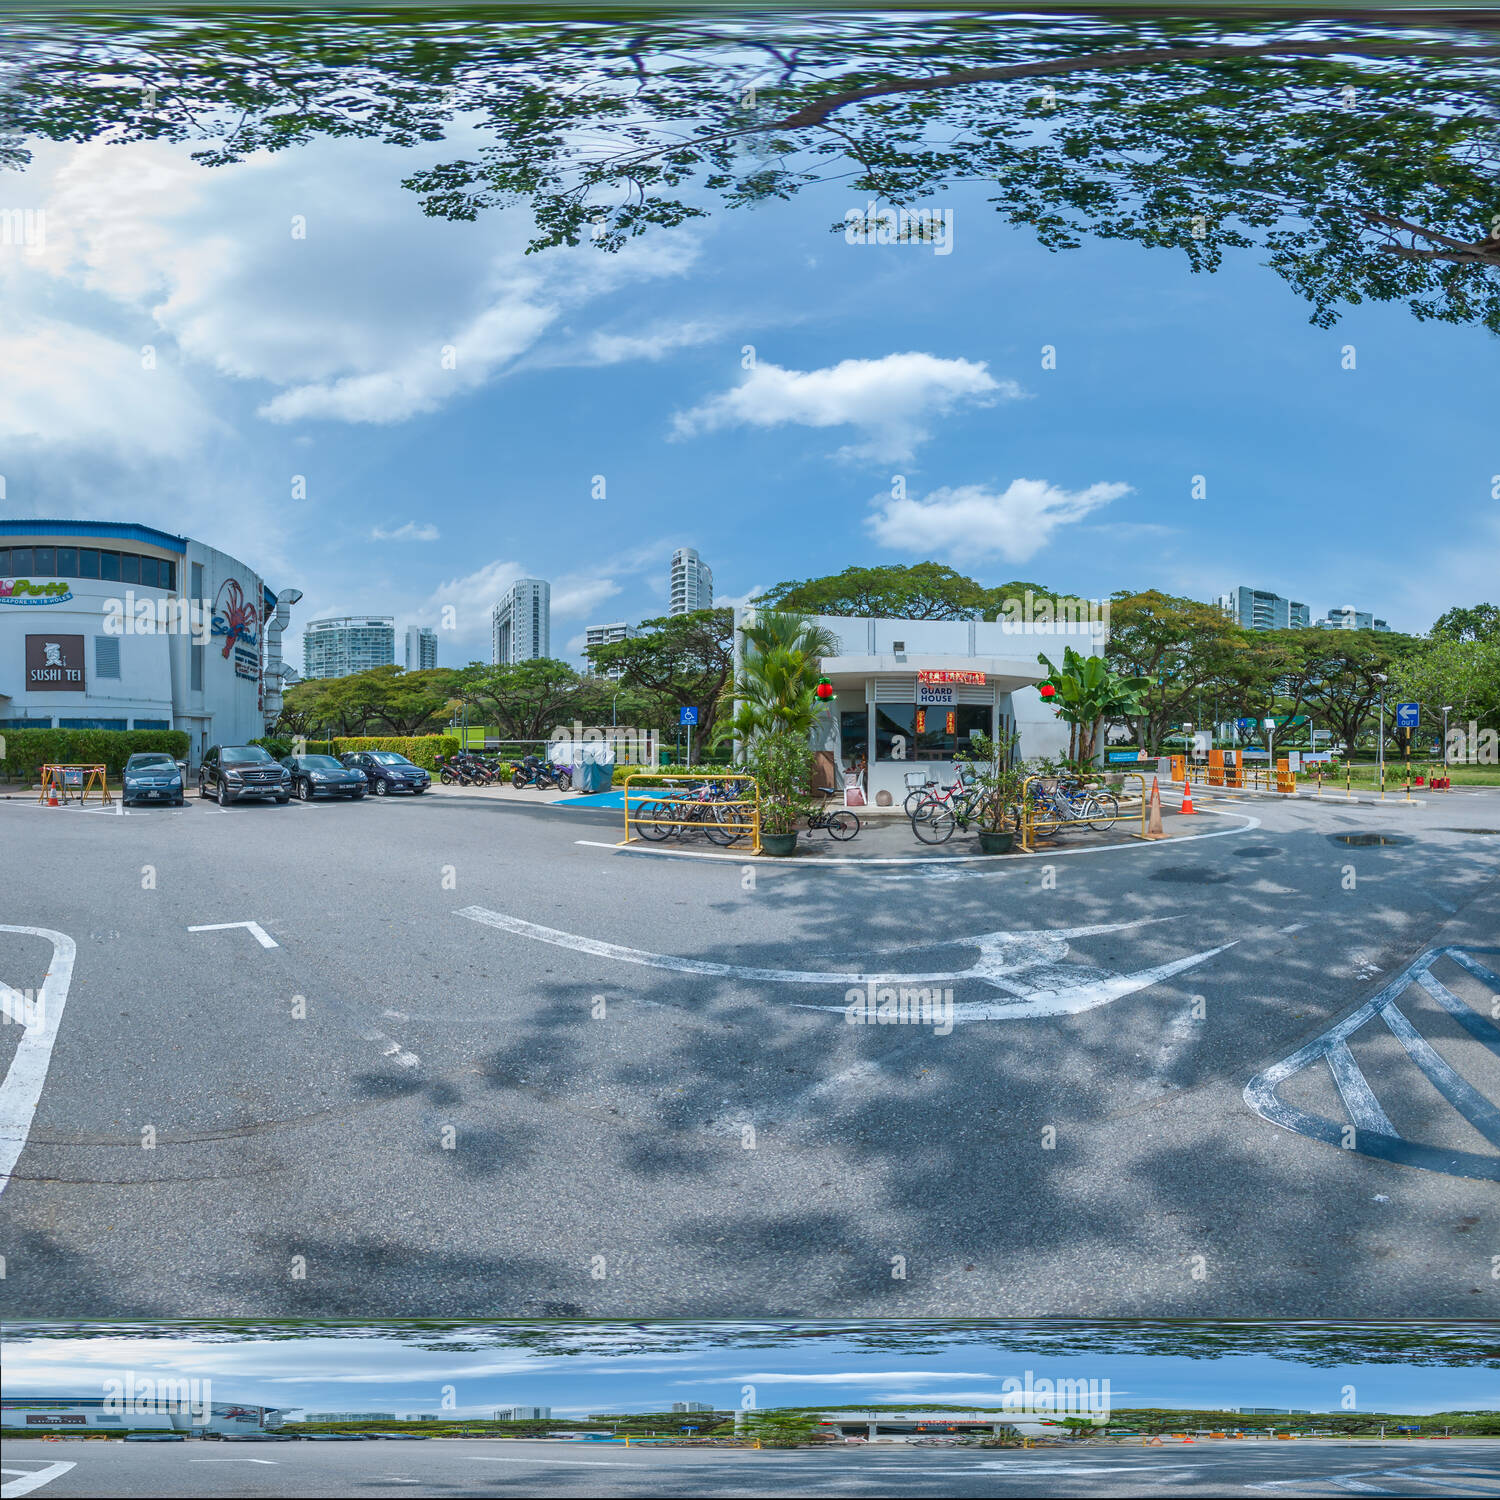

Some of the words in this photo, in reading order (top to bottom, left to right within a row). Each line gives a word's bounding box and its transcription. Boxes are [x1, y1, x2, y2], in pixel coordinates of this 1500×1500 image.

[31, 669, 62, 681] SUSHI
[65, 669, 81, 681] TEI
[921, 687, 952, 695] GUARD
